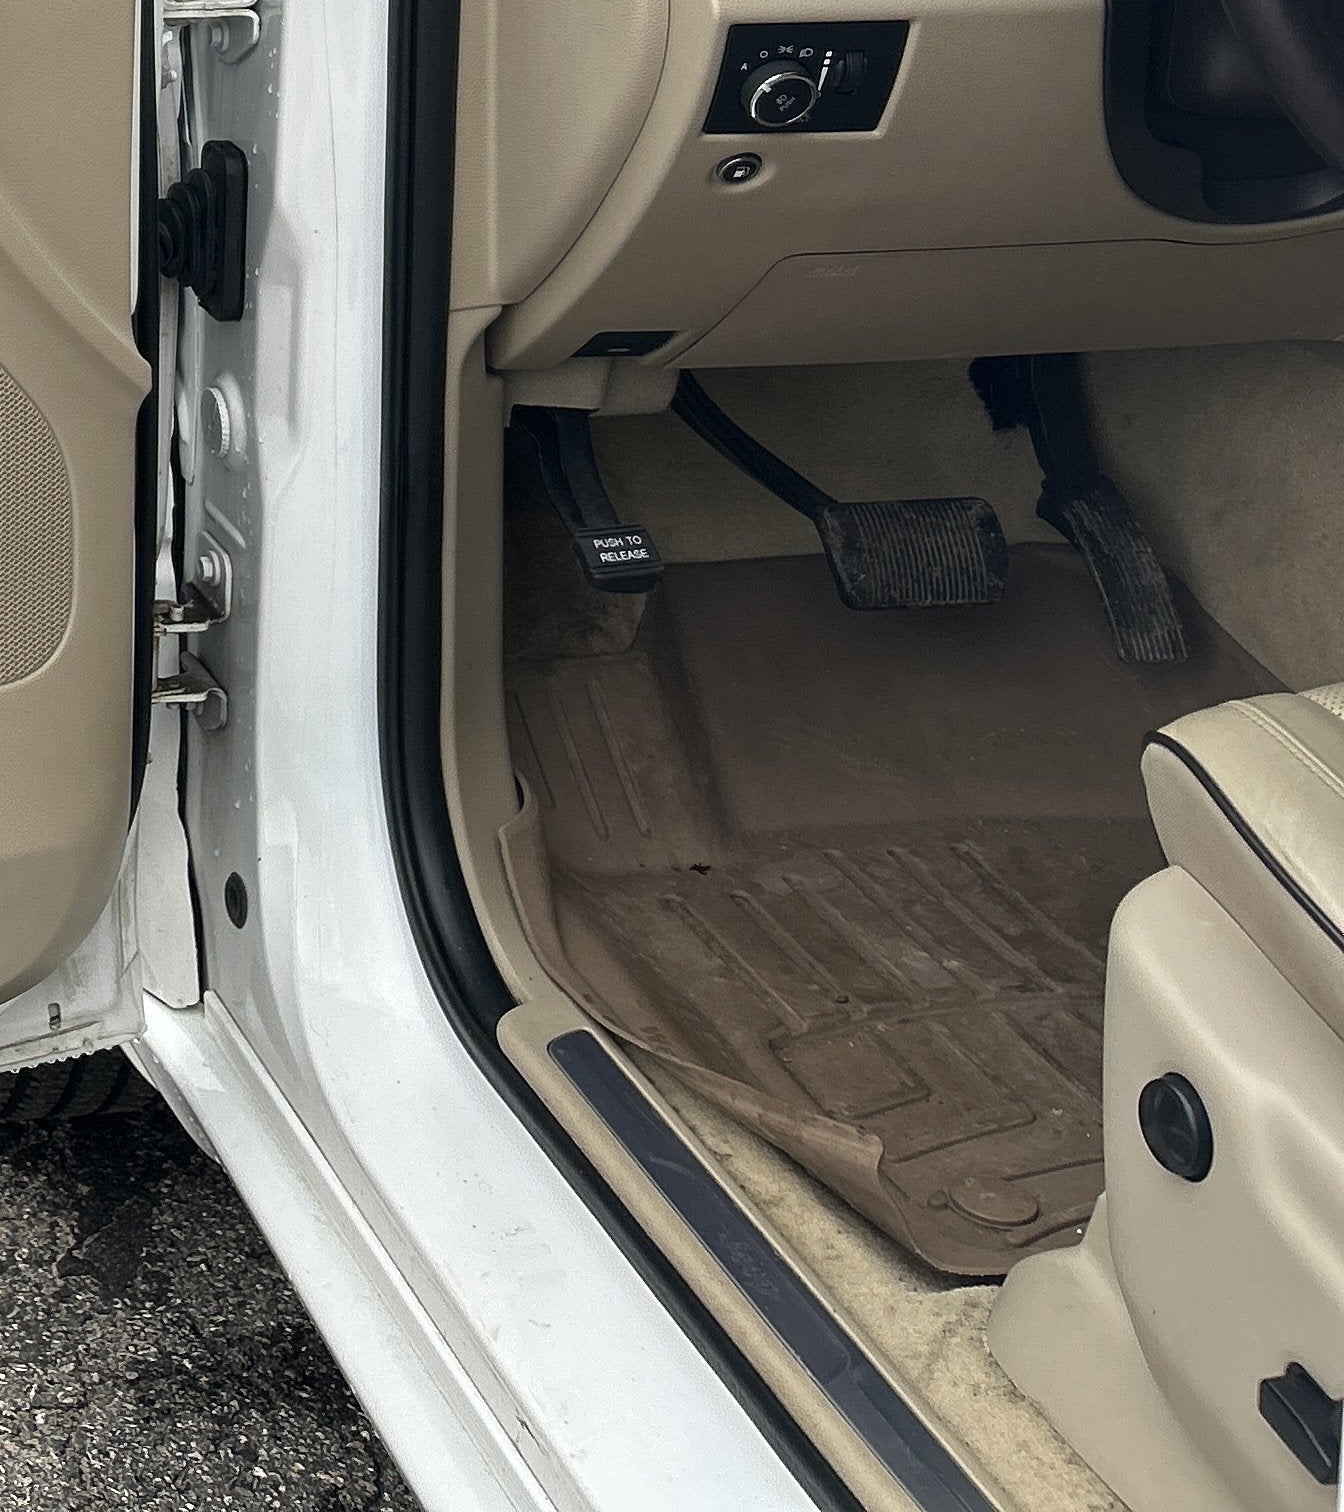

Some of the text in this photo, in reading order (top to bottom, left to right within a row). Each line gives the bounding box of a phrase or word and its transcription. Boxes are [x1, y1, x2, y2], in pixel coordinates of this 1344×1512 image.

[593, 535, 642, 549] PUSH TO
[599, 548, 650, 563] RELEASE
